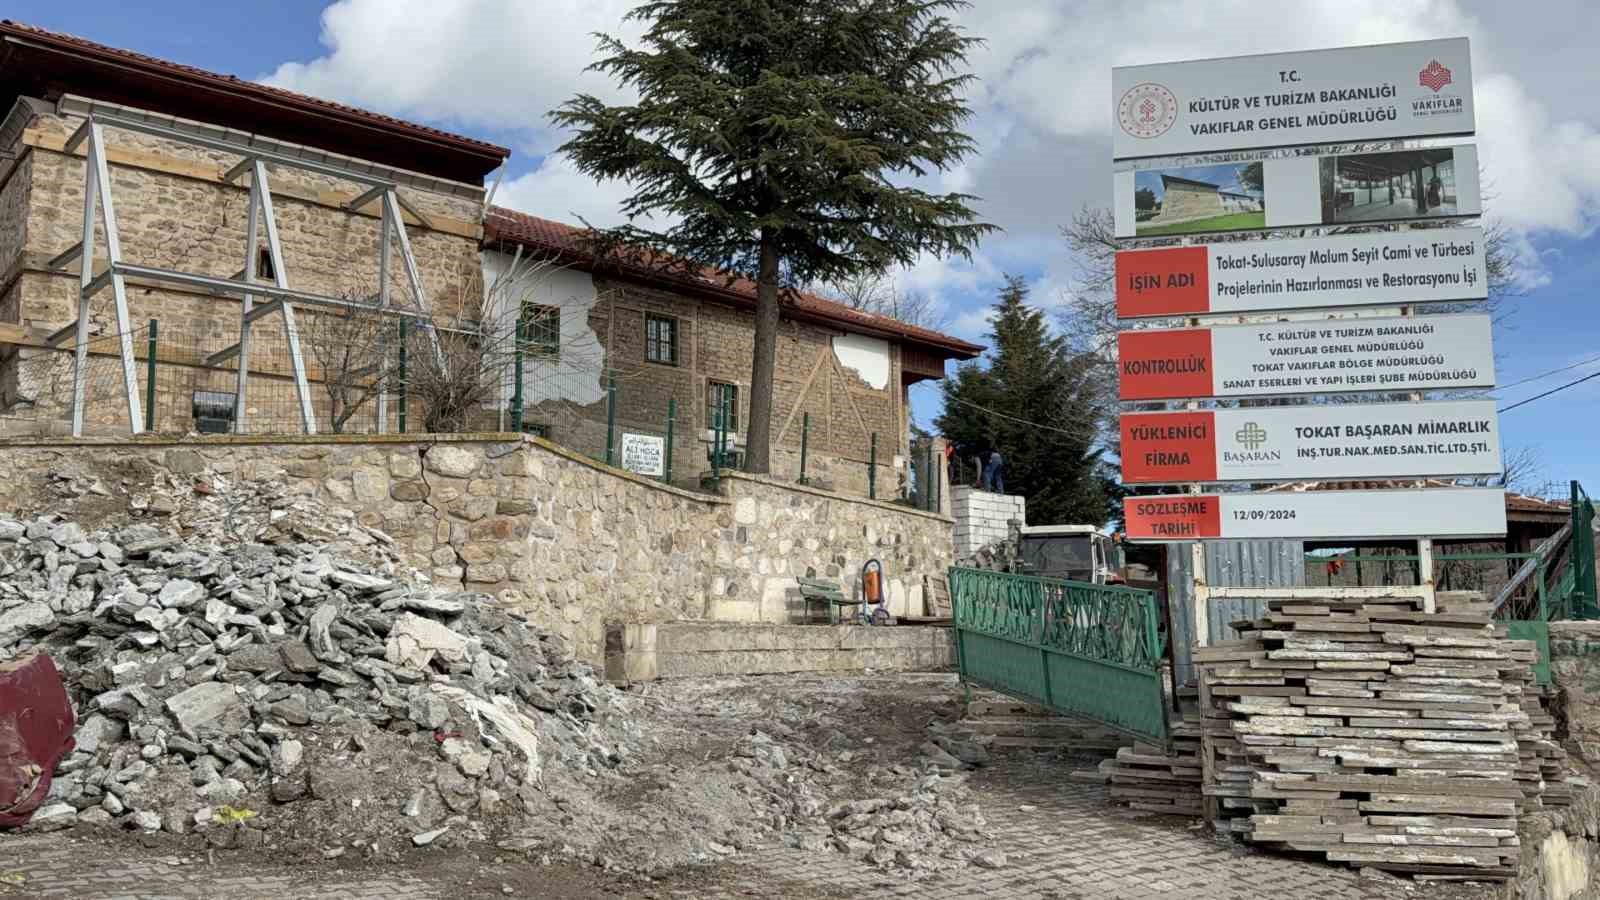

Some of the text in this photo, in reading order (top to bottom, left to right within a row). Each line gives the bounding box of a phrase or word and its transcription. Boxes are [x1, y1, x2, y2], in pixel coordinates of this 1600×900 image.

[1279, 71, 1301, 82] T.C.
[1189, 83, 1396, 113] KÜLTÜR VE TURİZM BAKANLIĞI
[1412, 98, 1462, 110] VAKIFLAR
[1190, 119, 1255, 135] VAKIFLAR
[1259, 116, 1302, 130] GENEL
[1306, 108, 1397, 126] MÜDÜRLÜĞÜ
[1216, 241, 1475, 271] Tokat-Sulusaray Malum Seyit Cami ve Türbesi
[1129, 272, 1195, 293] İŞİN ADI
[1217, 265, 1477, 298] Projelerinin Hazırlanması ve Restorasyonu İşi
[1258, 324, 1434, 342] T.C. KÜLTÜR VE TURİZM BAKANLIĞI
[1269, 340, 1424, 356] VAKIFLAR GENEL MÜDÜRLÜĞÜ
[1123, 354, 1206, 375] KONTROLLÜK
[1252, 355, 1444, 373] TOKAT VAKIFLAR BÖLGE MÜDÜRLÜĞÜ
[1223, 368, 1476, 389] SANAT ESERLERİ VE YAPI İŞLERİ ŞUBE MÜDÜRLÜĞÜ
[1130, 423, 1207, 441] YÜKLENİCİ
[1295, 419, 1490, 440] TOKAT BAŞARAN MİMARLIK
[1145, 450, 1191, 466] FİRMA
[1223, 449, 1280, 464] BAŞARAN
[1297, 441, 1491, 459] İNŞ.TUR.NAK.MED.SAN.TİC.LTD.ŞTİ.
[1137, 501, 1207, 518] SÖZLEŞME
[1233, 509, 1296, 521] 12/09/2024
[1152, 521, 1195, 536] TARİHİ
